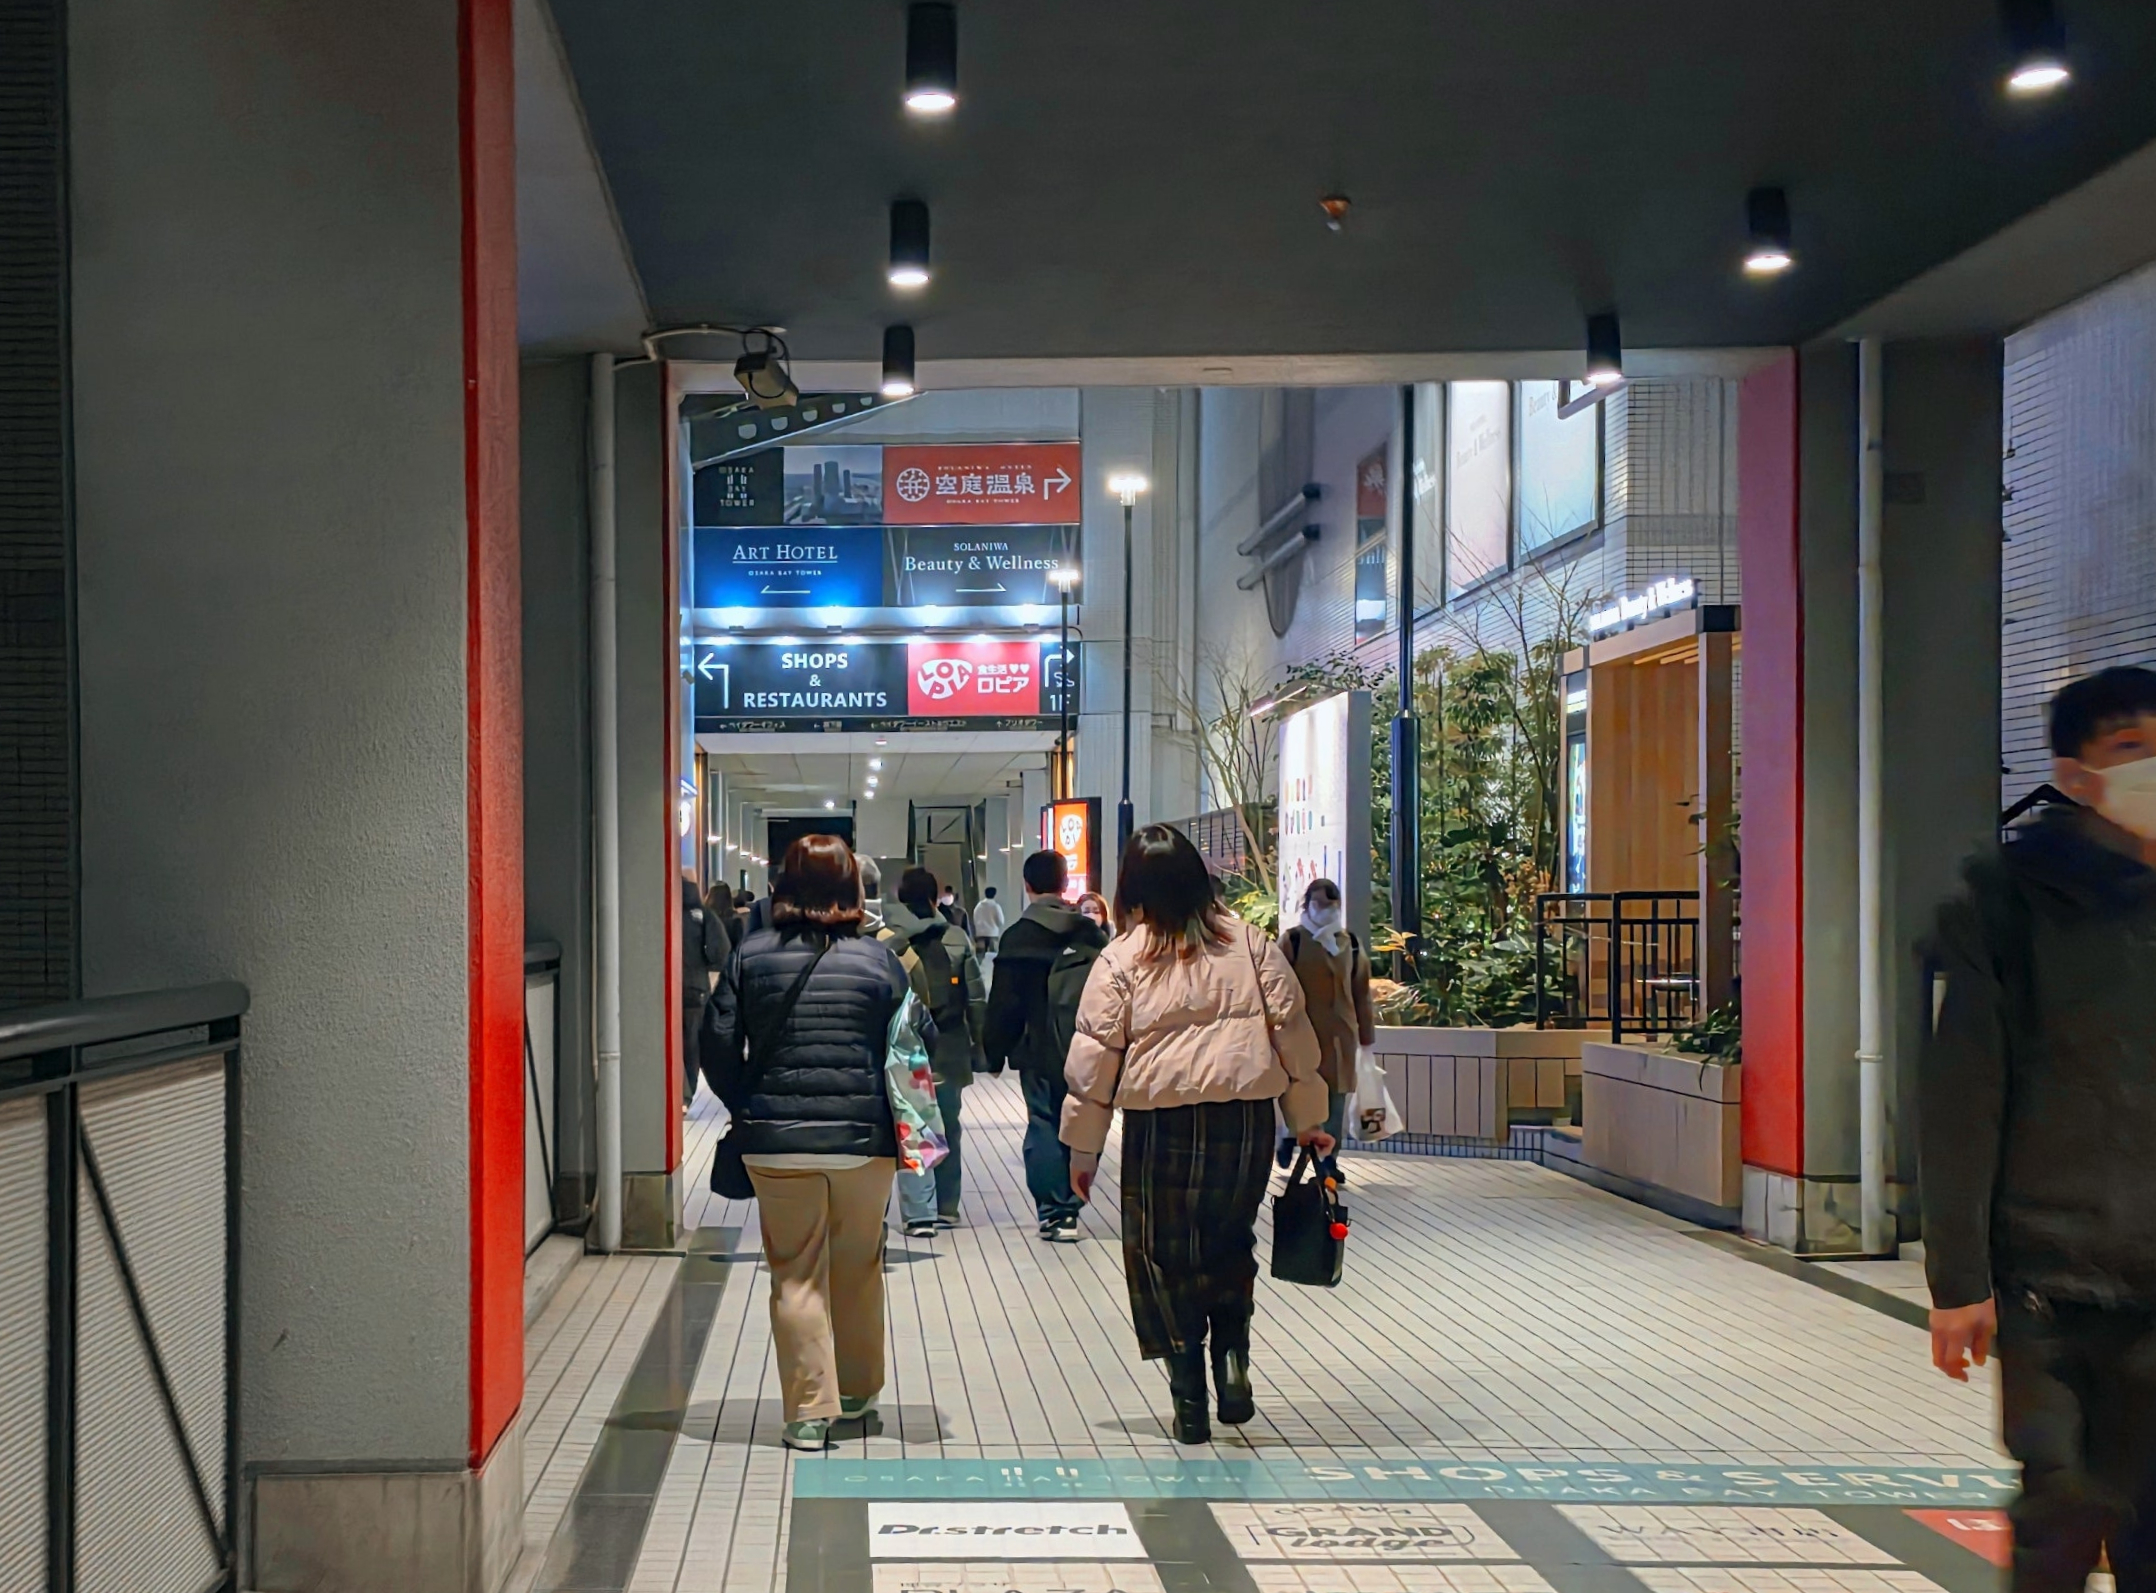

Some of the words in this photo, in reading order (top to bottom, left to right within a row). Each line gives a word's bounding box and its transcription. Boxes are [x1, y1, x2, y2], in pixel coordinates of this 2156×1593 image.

[935, 472, 1035, 495] 空庭温泉
[732, 545, 770, 560] ART
[776, 544, 838, 560] HOTEL
[953, 542, 1009, 551] SOLANIWA
[904, 556, 964, 574] Beauty
[968, 556, 981, 570] &
[986, 555, 1059, 570] Wellness
[781, 652, 848, 669] SHOPS
[809, 674, 821, 687] &
[977, 677, 1030, 694] ロピア
[743, 691, 888, 708] RESTAURANTS
[1304, 1465, 1633, 1483] SHOPS
[1656, 1469, 1707, 1482] &
[1722, 1470, 2021, 1489] SERVI
[878, 1524, 1128, 1535] Dr.stretch
[1267, 1526, 1454, 1538] GRAND
[1290, 1537, 1444, 1550] lodge
